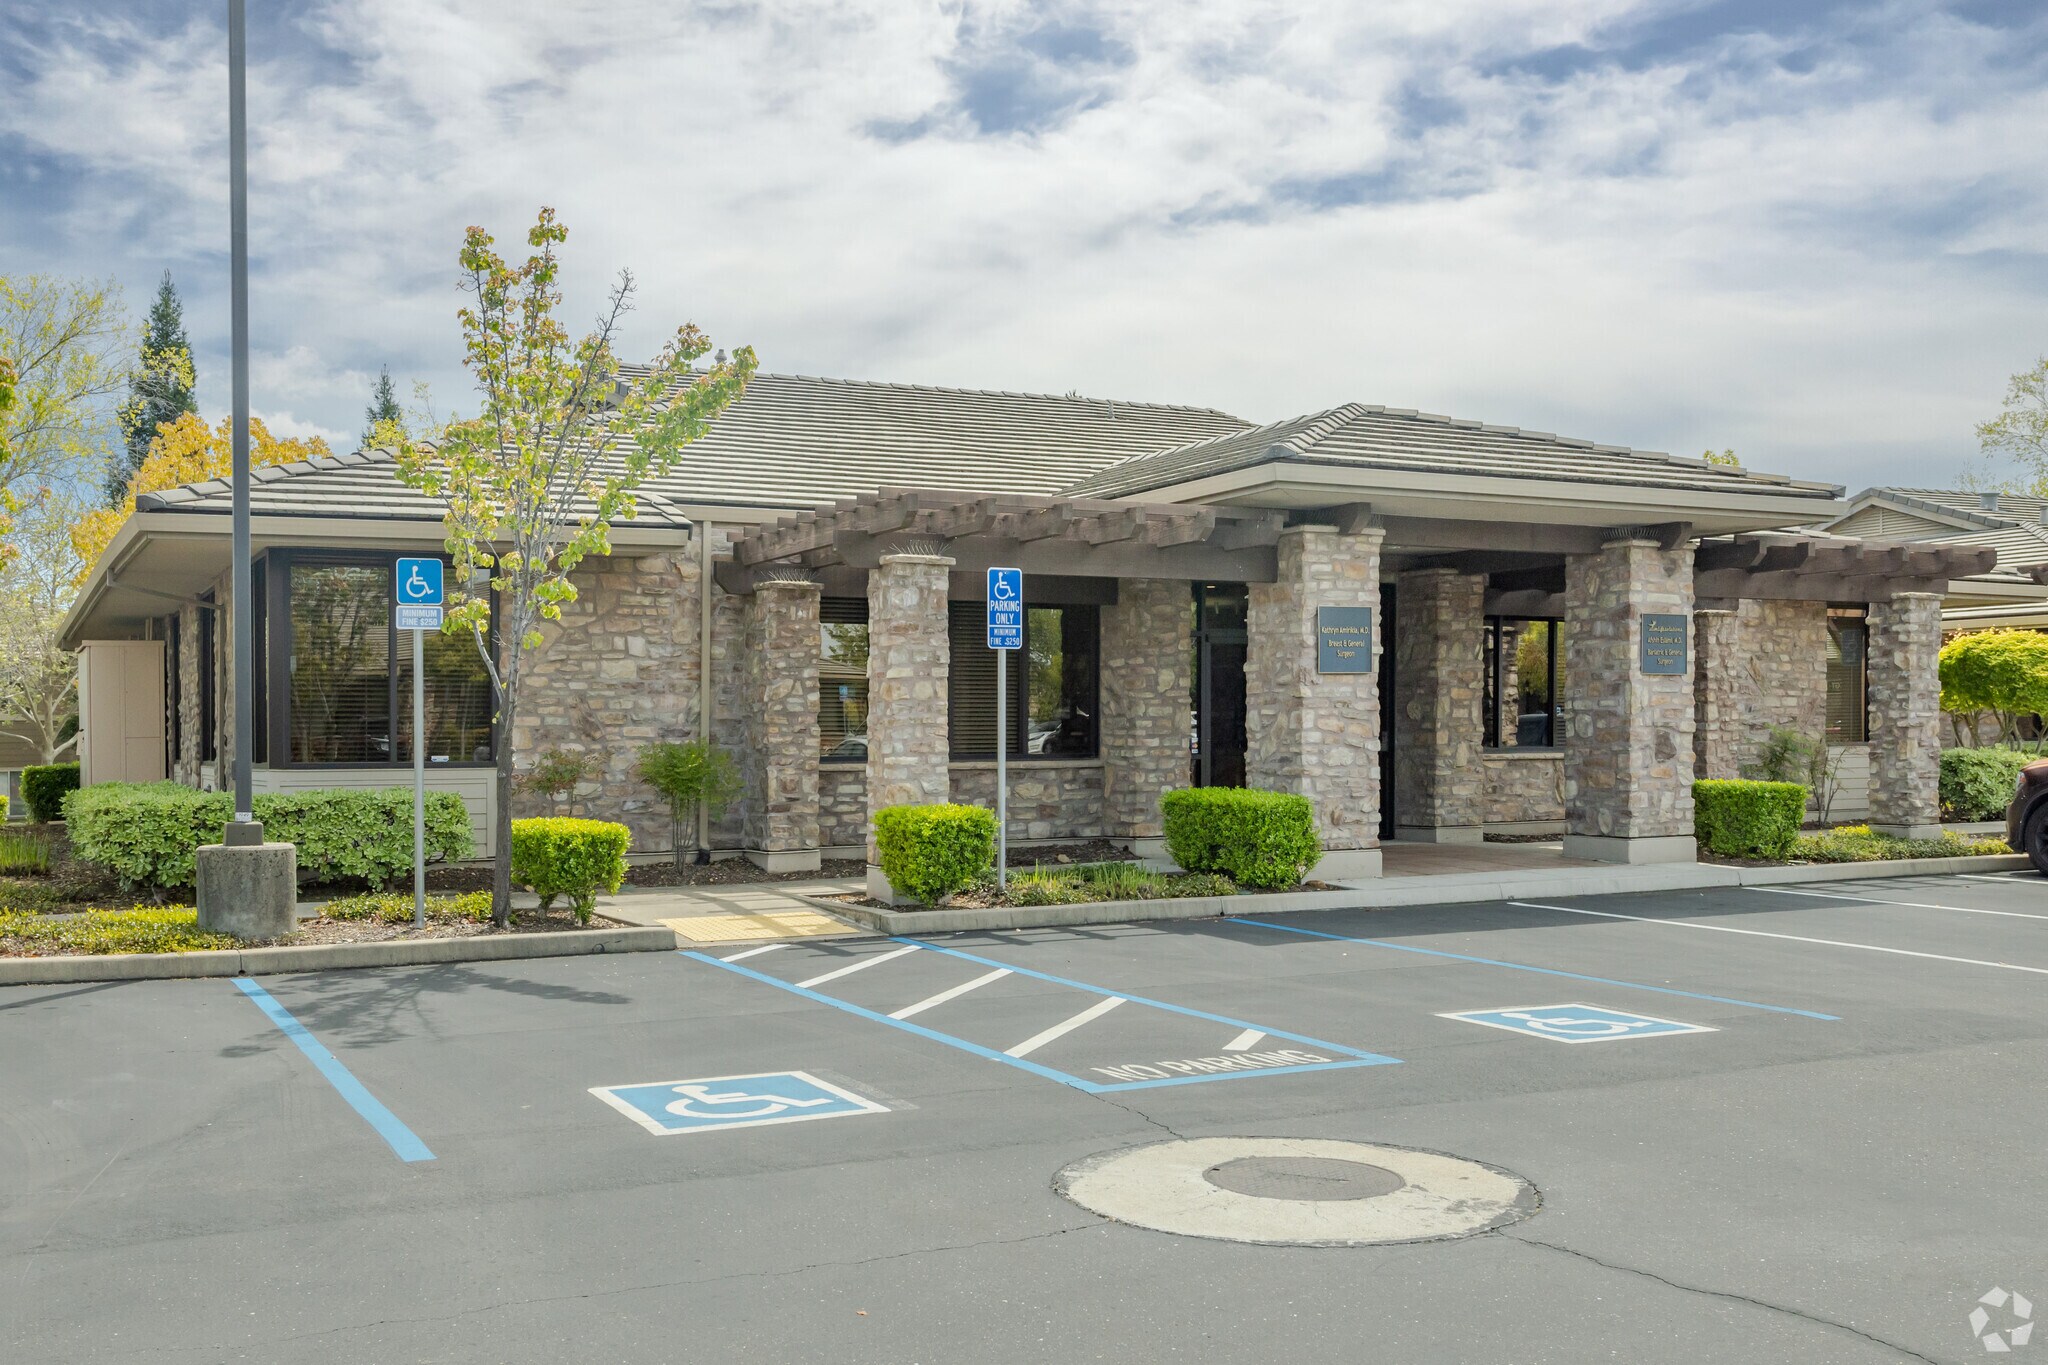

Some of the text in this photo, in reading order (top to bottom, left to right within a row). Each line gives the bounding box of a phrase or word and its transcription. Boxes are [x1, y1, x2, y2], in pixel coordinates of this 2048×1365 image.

[990, 600, 1020, 612] PARKING
[402, 609, 438, 617] MINIMUM
[402, 617, 438, 626] FINE $250
[995, 612, 1014, 625] ONLY
[993, 628, 1017, 637] MINIMUM
[990, 637, 1002, 646] FINE
[1347, 639, 1365, 647] General
[1337, 649, 1355, 659] Surgeon
[1090, 1049, 1333, 1082] NO PARKING
